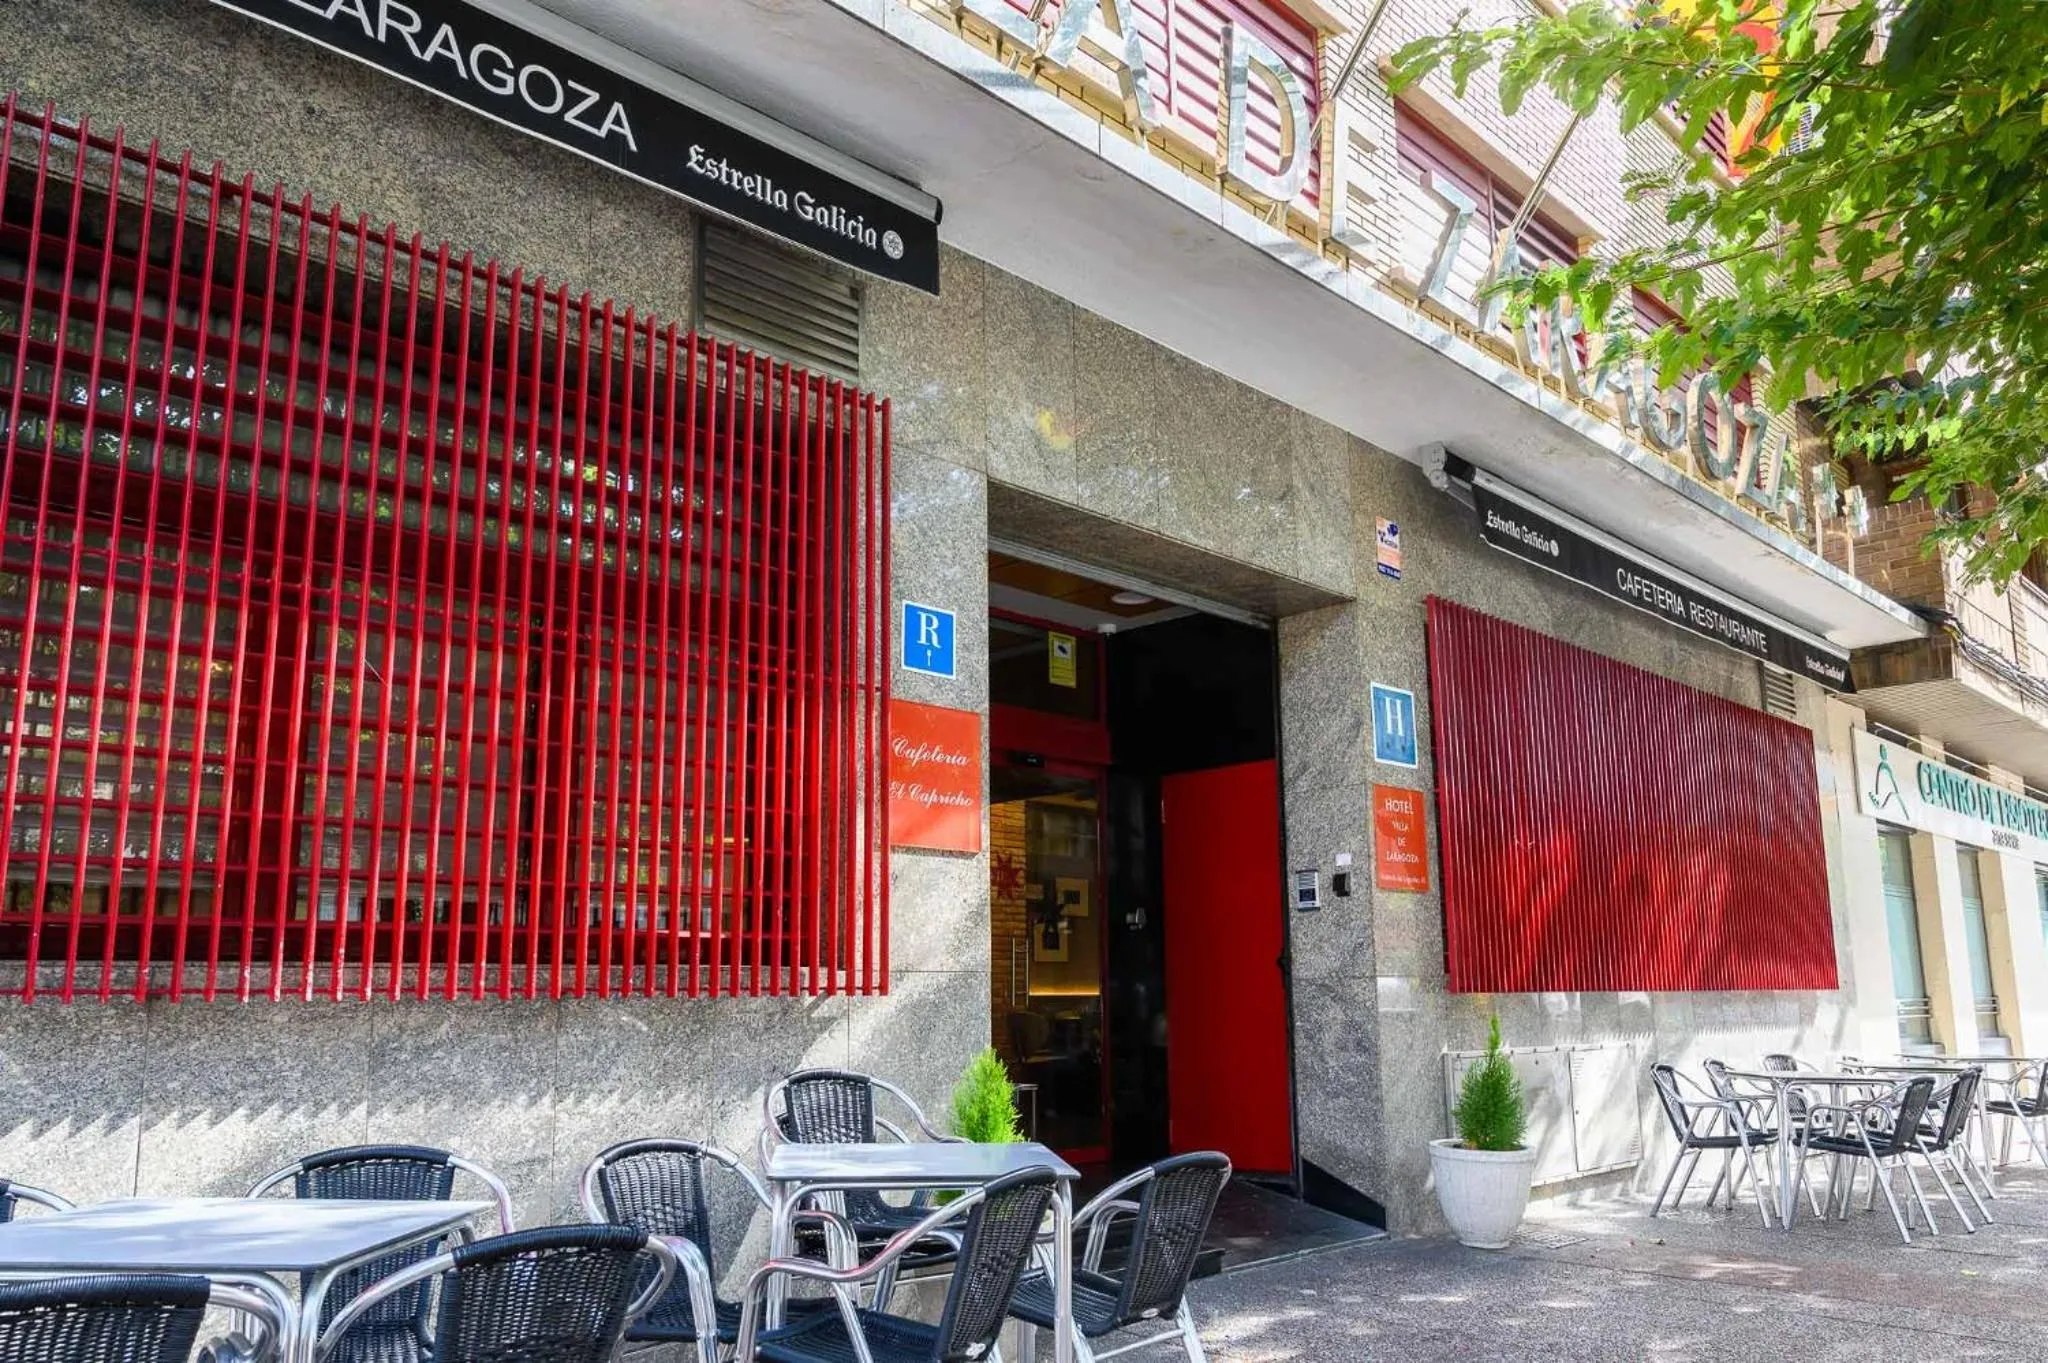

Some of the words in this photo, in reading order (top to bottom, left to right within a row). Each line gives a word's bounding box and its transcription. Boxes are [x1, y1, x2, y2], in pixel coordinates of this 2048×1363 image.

[288, 0, 638, 153] ARAGOZA
[686, 144, 788, 211] Estrella
[793, 191, 877, 250] Galicia
[1486, 509, 1521, 540] Estrella
[1616, 567, 1687, 618] CAFETERIA
[1689, 601, 1768, 652] RESTAURANTE
[916, 611, 942, 649] R
[1384, 696, 1404, 736] H
[888, 781, 906, 799] El
[909, 783, 974, 808] Capricho
[1385, 798, 1414, 815] HOTEL
[1917, 760, 1977, 818] CENTRO
[1977, 783, 1997, 825] DE
